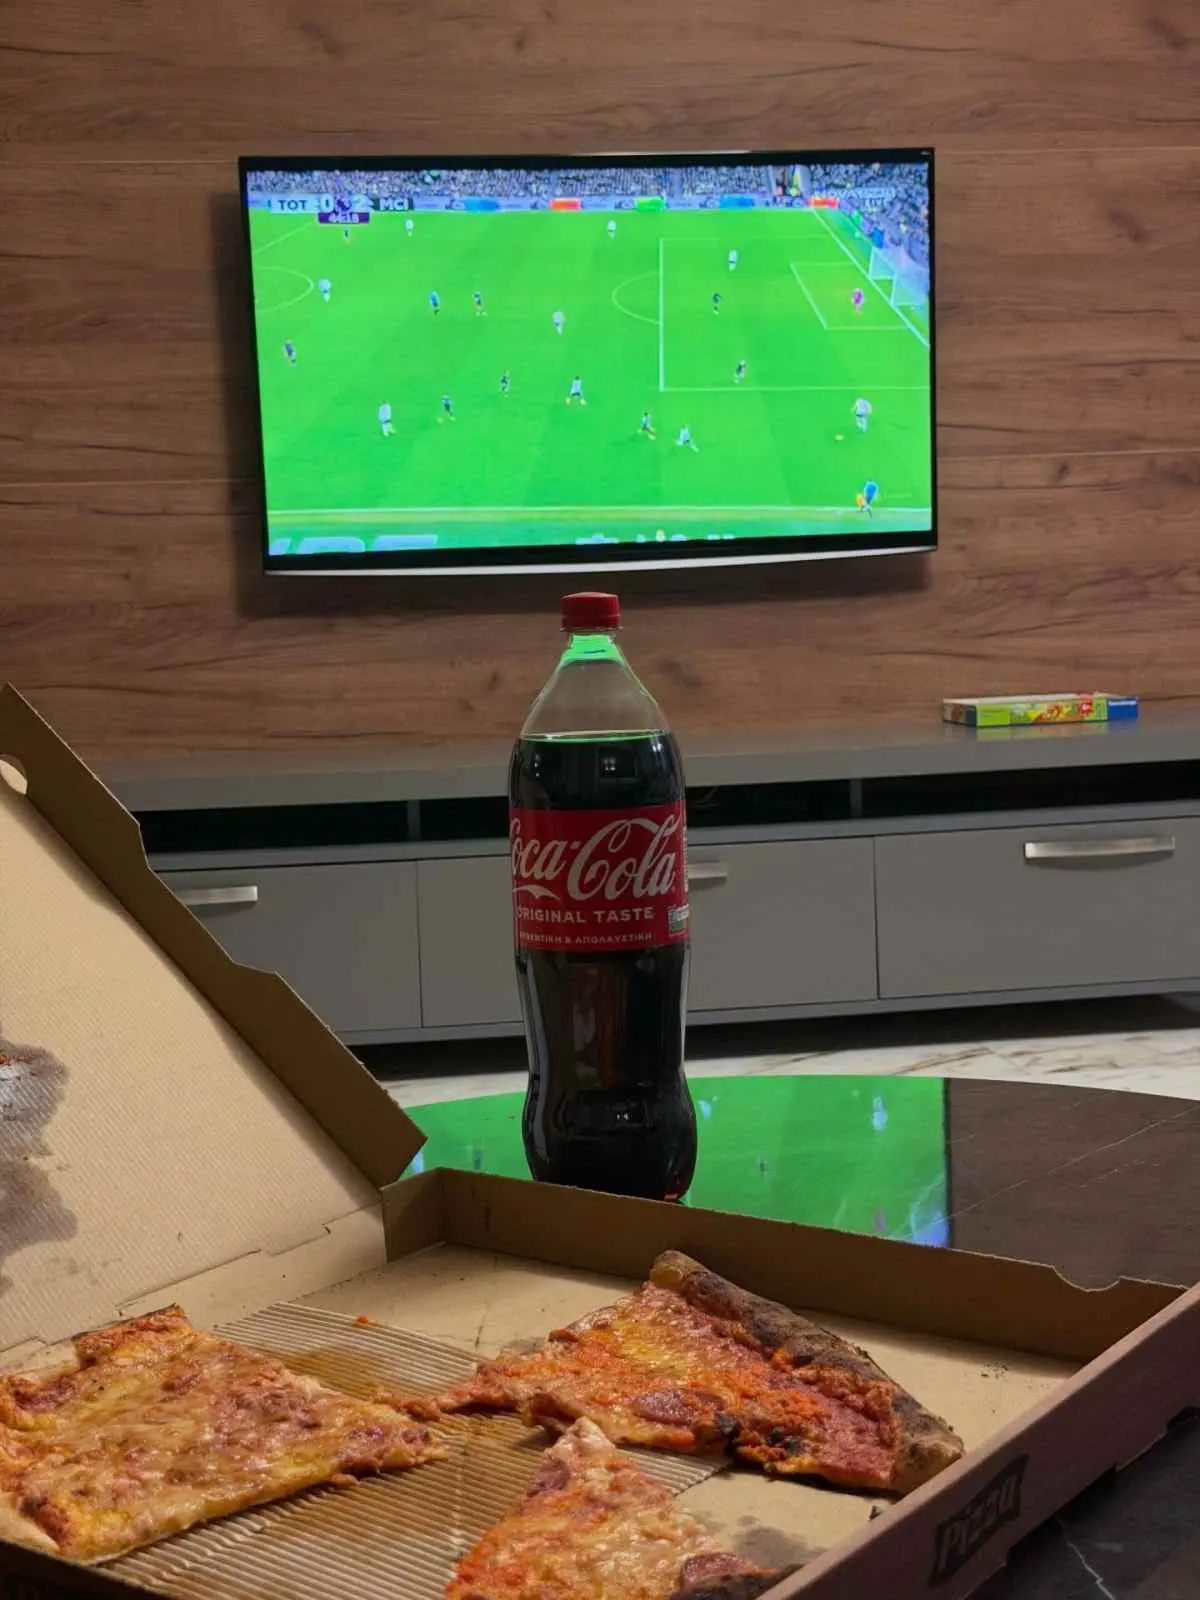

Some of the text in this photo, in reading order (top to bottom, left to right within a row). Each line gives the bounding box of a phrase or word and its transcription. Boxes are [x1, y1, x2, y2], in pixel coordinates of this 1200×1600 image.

[277, 199, 307, 210] TOT
[319, 193, 334, 212] 0
[379, 197, 409, 211] MCI
[594, 906, 656, 923] TASTE
